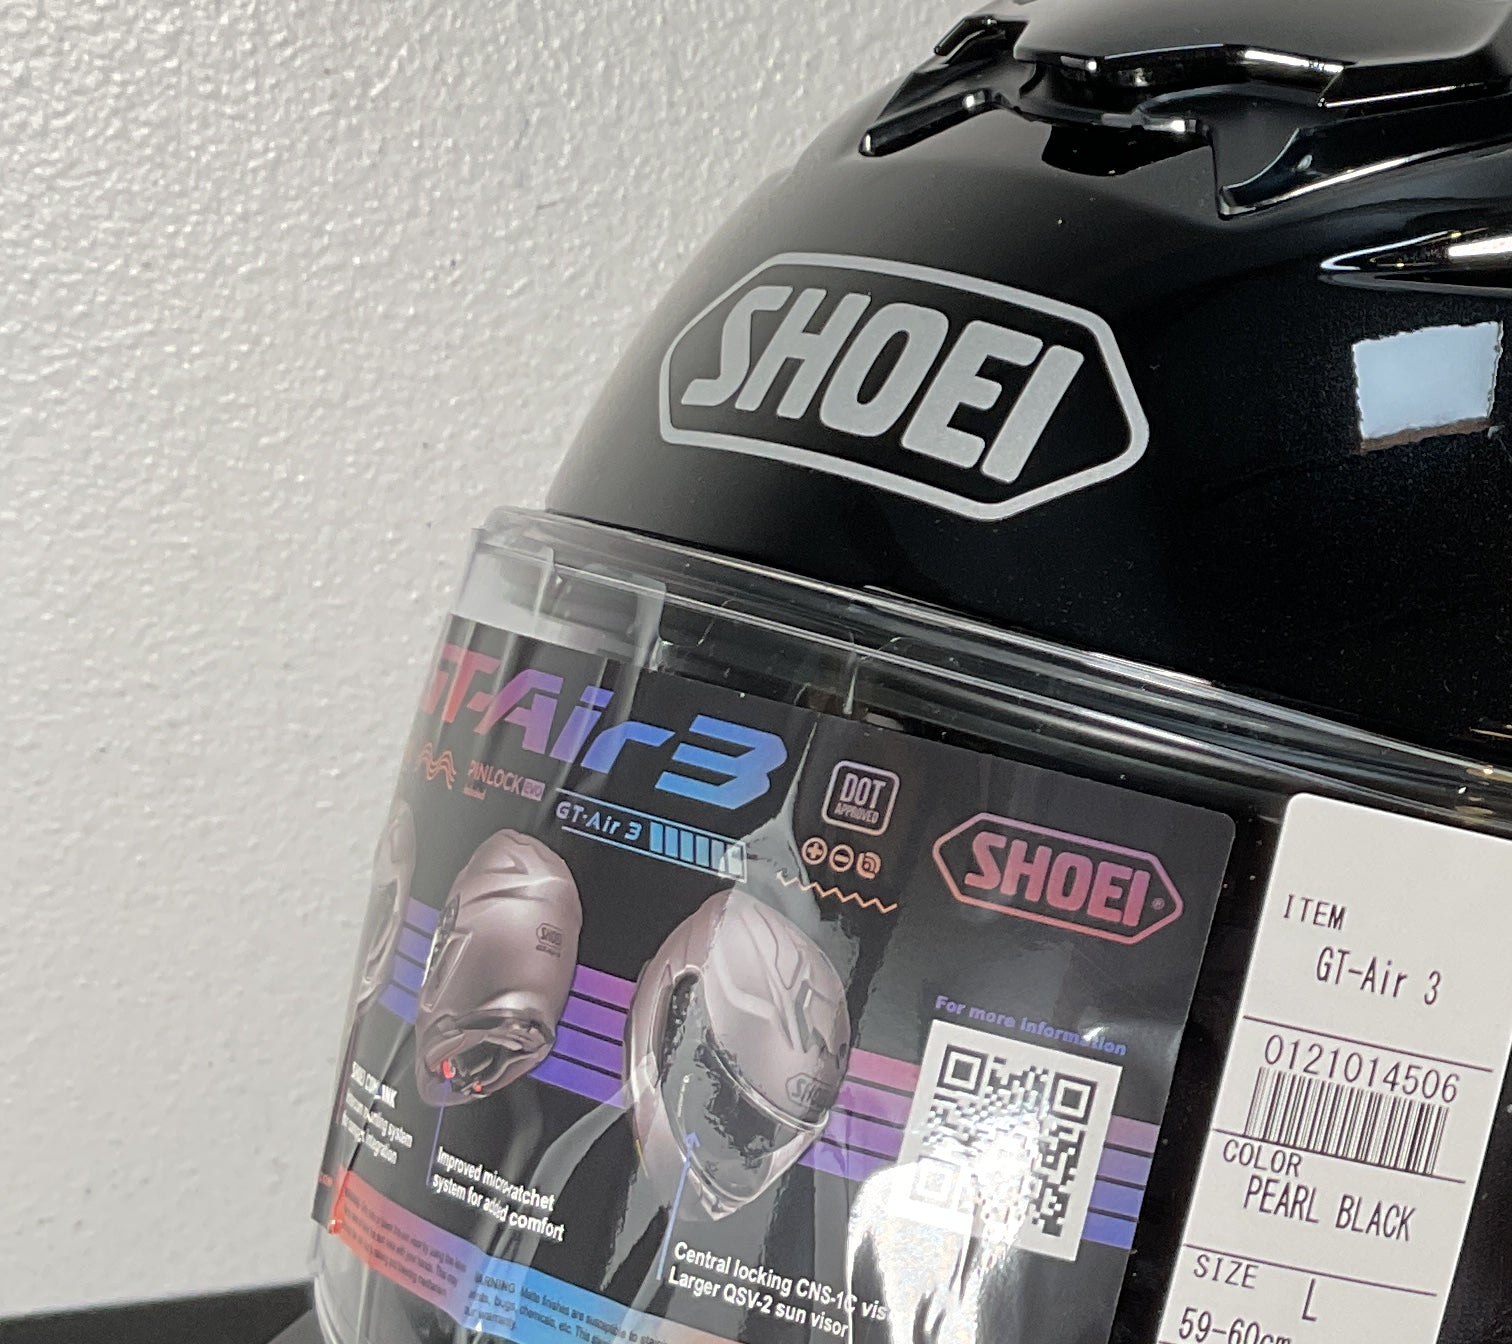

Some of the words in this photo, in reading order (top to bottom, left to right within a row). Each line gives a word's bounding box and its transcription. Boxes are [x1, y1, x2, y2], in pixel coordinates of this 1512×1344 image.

[681, 285, 1085, 484] SHOEI
[834, 802, 879, 824] APPROVED
[839, 772, 887, 808] DOT
[624, 821, 643, 842] 3
[965, 831, 1150, 927] SHOEI
[1283, 893, 1347, 931] ITEM
[1316, 946, 1408, 998] GT-Air
[1423, 971, 1442, 1005] 3
[935, 995, 964, 1014] For
[969, 1007, 1016, 1028] more
[1264, 1033, 1459, 1104] 0121014506
[437, 1146, 483, 1181] Improved
[1223, 1139, 1303, 1177] COLOR
[433, 1173, 467, 1201] system
[467, 1186, 484, 1207] for
[509, 1211, 565, 1242] comfort
[1244, 1175, 1319, 1224] PEARL
[1336, 1195, 1416, 1242] BLACK
[668, 1266, 721, 1297] Larger
[723, 1283, 773, 1315] QSV-2
[775, 1303, 807, 1325] sun
[811, 1311, 849, 1338] visor
[674, 1241, 732, 1275] Central
[734, 1259, 793, 1298] locking
[795, 1278, 858, 1313] CNS-1C
[862, 1301, 889, 1322] vis
[1194, 1253, 1260, 1290] SIZE
[1301, 1278, 1317, 1322] L
